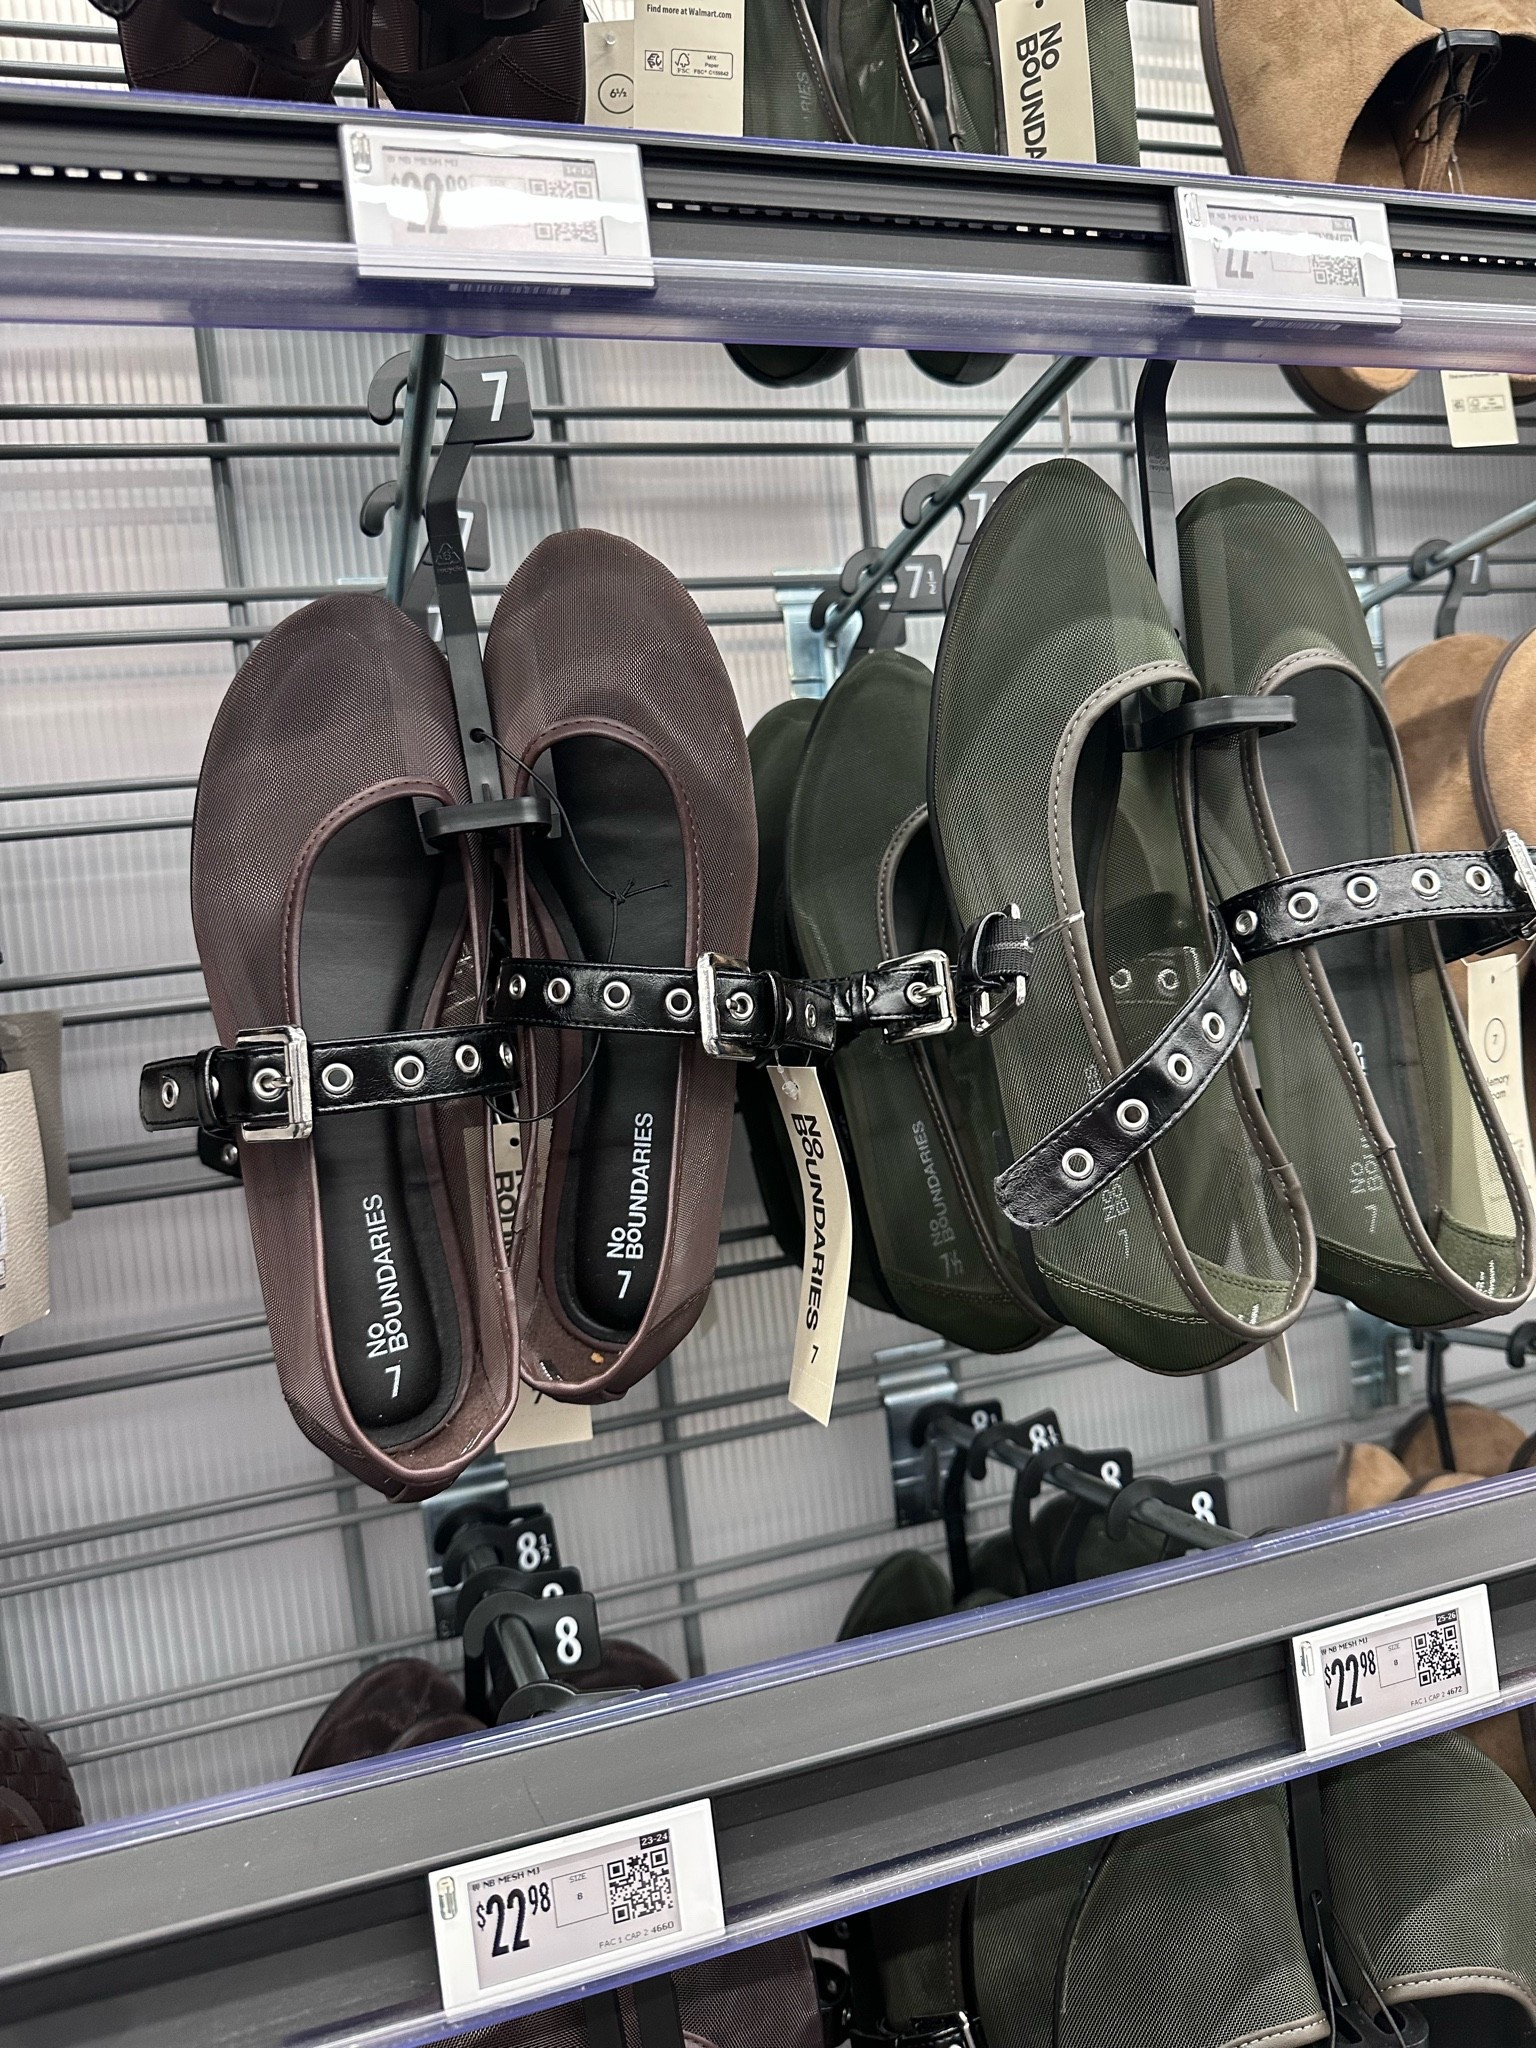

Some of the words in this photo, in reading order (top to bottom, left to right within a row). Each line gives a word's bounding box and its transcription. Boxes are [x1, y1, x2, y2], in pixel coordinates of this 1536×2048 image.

[646, 4, 661, 13] Find
[662, 7, 679, 15] more
[688, 8, 732, 19] Walmart.com
[1037, 21, 1062, 71] NO
[481, 370, 508, 422] 7
[804, 1115, 824, 1159] NO
[625, 1112, 654, 1260] BOUNDARIES
[912, 1120, 956, 1243] BOUNDARIES
[791, 1113, 826, 1331] BOUNDARIES
[929, 1216, 948, 1247] NO
[607, 1227, 626, 1258] NO
[363, 1193, 409, 1355] BOUNDARIES
[617, 1270, 632, 1299] 7
[366, 1322, 388, 1359] NO
[810, 1345, 819, 1365] 7
[384, 1364, 401, 1398] 7
[1437, 1611, 1456, 1624] 25-26
[555, 1616, 582, 1664] 8
[1338, 1639, 1357, 1650] MESH
[1410, 1697, 1423, 1707] FAC
[1428, 1692, 1441, 1702] CAP
[1446, 1685, 1463, 1696] 4672
[641, 1832, 669, 1847] 23-24
[483, 1879, 496, 1888] NB
[498, 1871, 525, 1884] MESH
[569, 1872, 587, 1884] SIZE
[598, 1938, 617, 1949] FAC
[624, 1930, 642, 1941] CAP
[643, 1928, 650, 1937] 2
[651, 1920, 675, 1934] 4660
